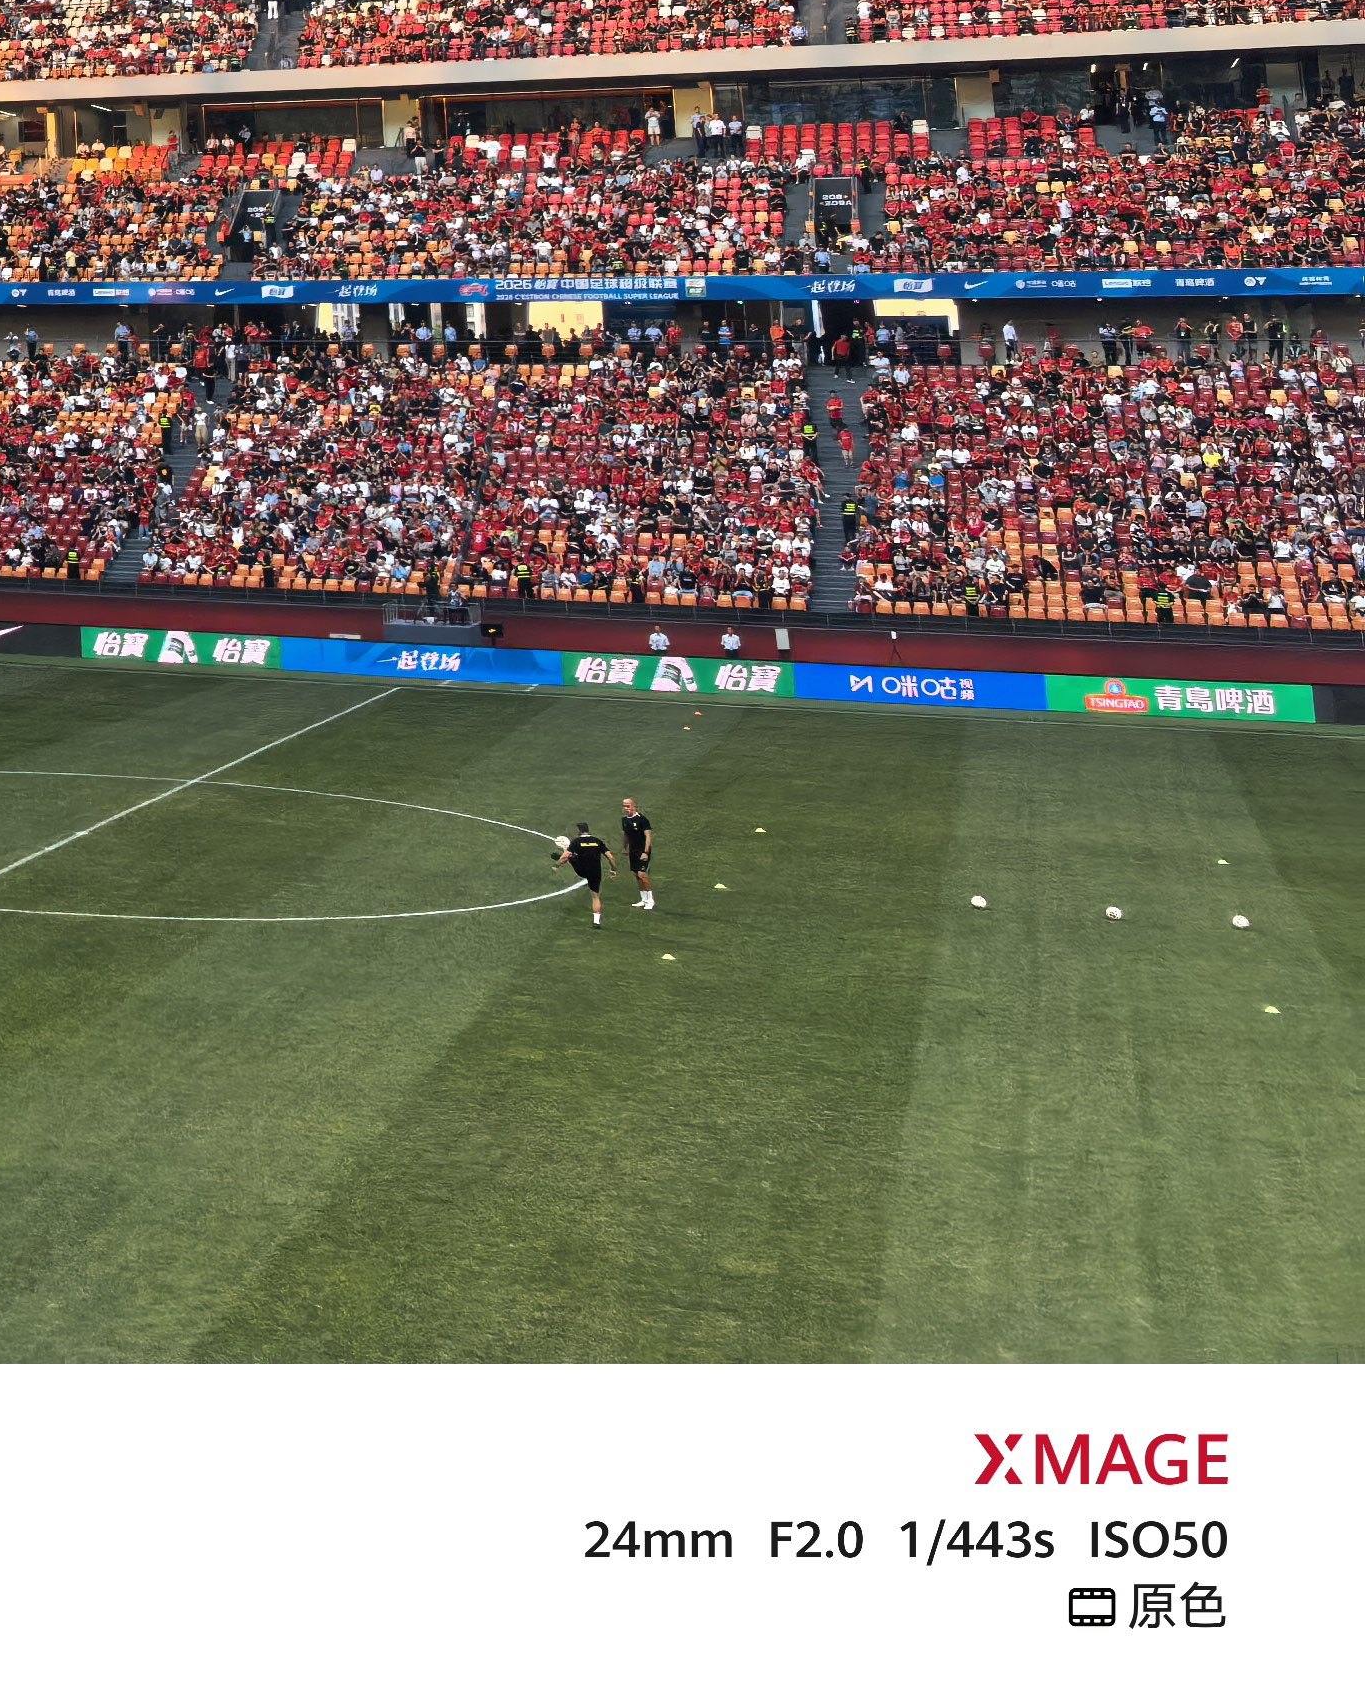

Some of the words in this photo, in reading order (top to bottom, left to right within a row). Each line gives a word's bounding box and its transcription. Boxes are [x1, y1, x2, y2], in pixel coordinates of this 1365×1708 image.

[495, 279, 533, 290] 2026
[560, 279, 678, 290] 中国足球超级联赛
[93, 632, 148, 657] 怡寶
[213, 638, 270, 664] 怡寶
[575, 657, 638, 685] 怡寶
[715, 664, 781, 692] 怡寶
[1088, 697, 1147, 710] TSINGTAO
[1155, 686, 1275, 714] 青岛啤酒
